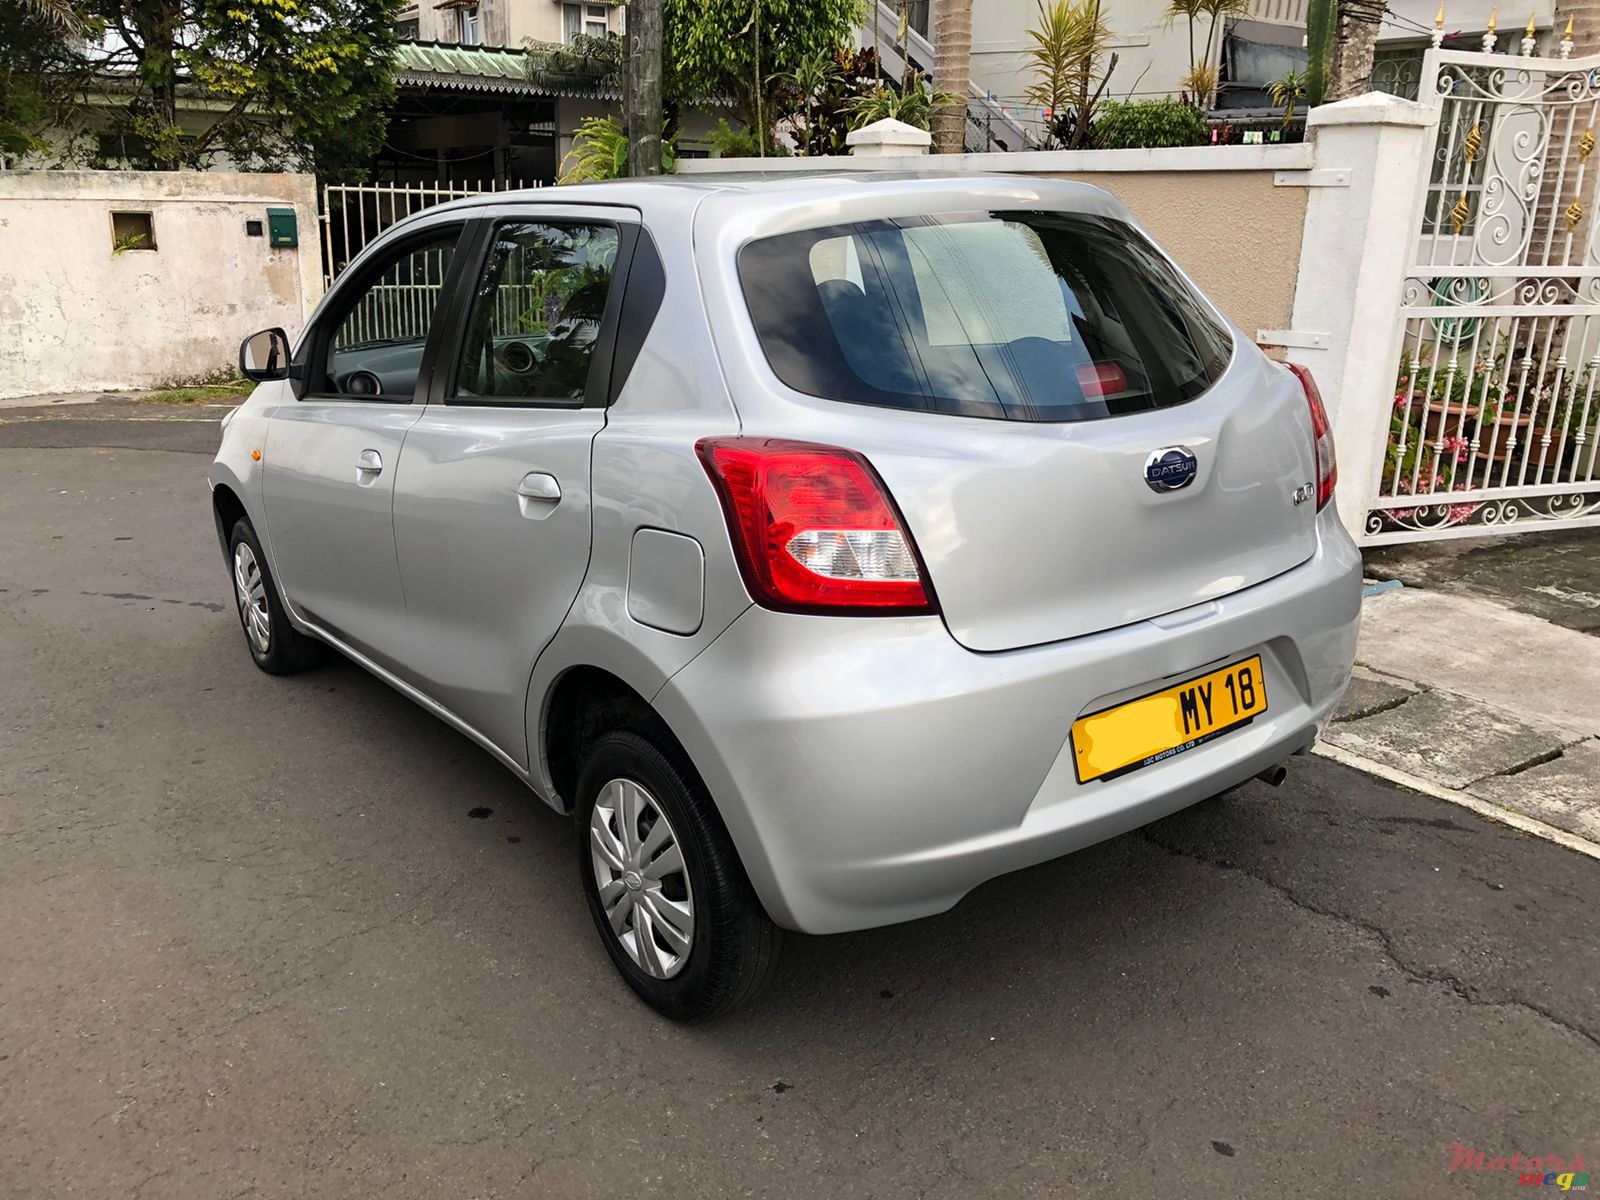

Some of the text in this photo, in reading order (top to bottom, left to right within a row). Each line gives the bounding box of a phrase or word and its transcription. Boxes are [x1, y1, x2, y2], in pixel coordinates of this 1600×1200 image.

[631, 36, 642, 58] 2
[1151, 460, 1195, 478] DATSUN
[1179, 667, 1256, 735] MY 18
[1155, 748, 1177, 761] MOTORS
[1186, 740, 1195, 749] LTD
